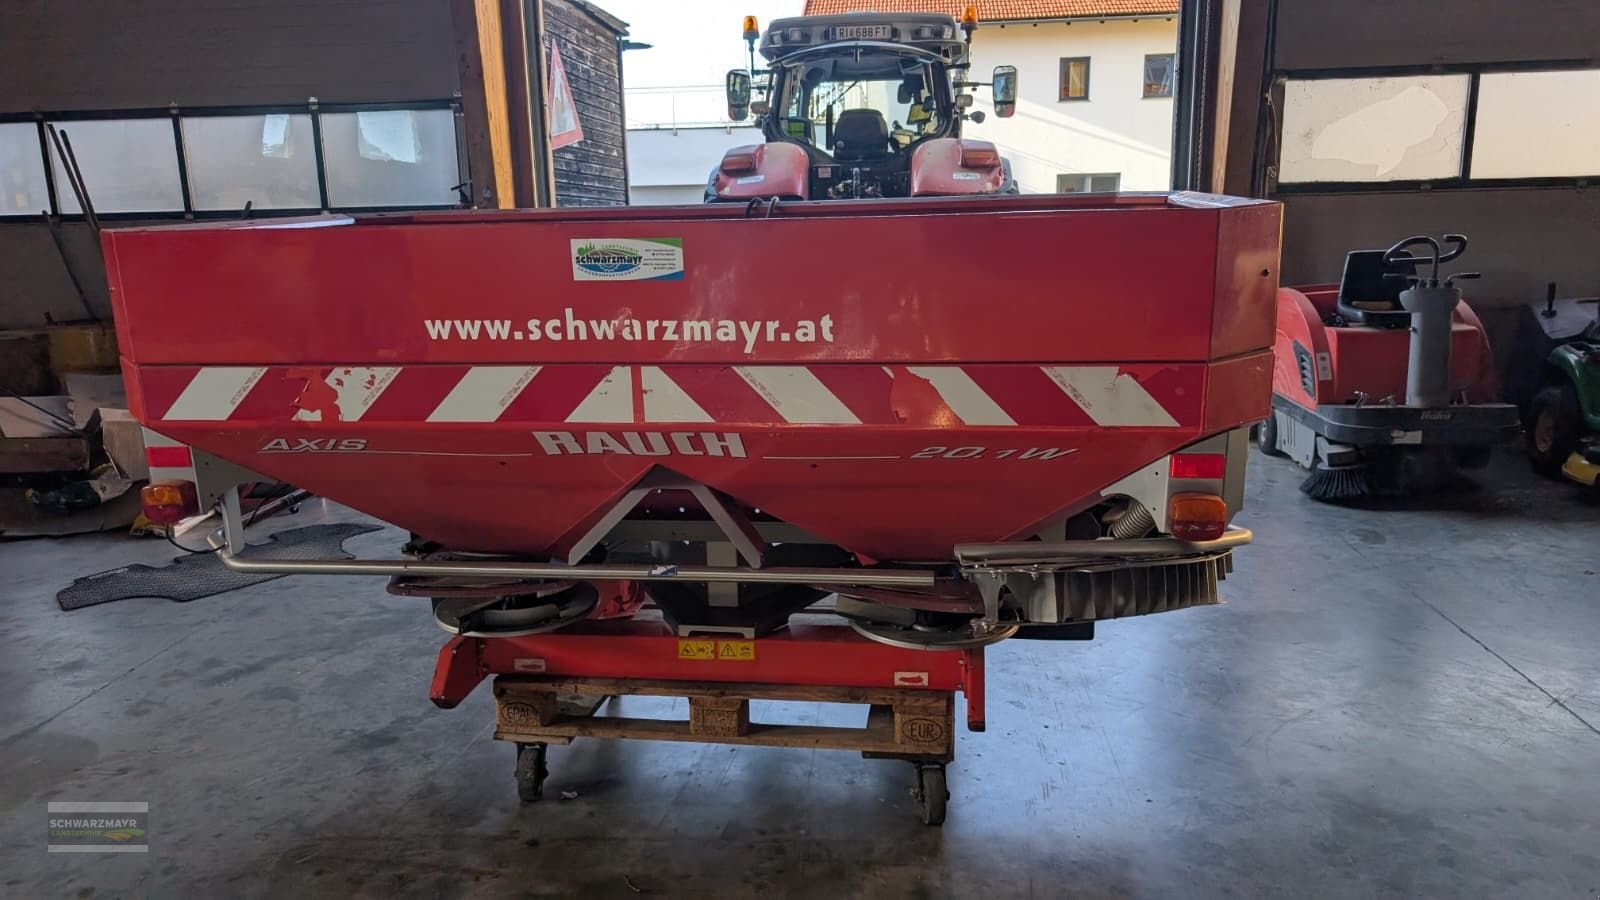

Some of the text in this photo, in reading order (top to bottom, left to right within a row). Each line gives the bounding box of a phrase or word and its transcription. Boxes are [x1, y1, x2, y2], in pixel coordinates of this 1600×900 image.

[839, 27, 849, 38] RI
[575, 254, 643, 265] schwarzmayr
[423, 307, 834, 354] www.schwarzmayr.at
[260, 438, 368, 451] AXIS
[531, 430, 748, 458] RAUCH
[910, 722, 935, 738] EUR
